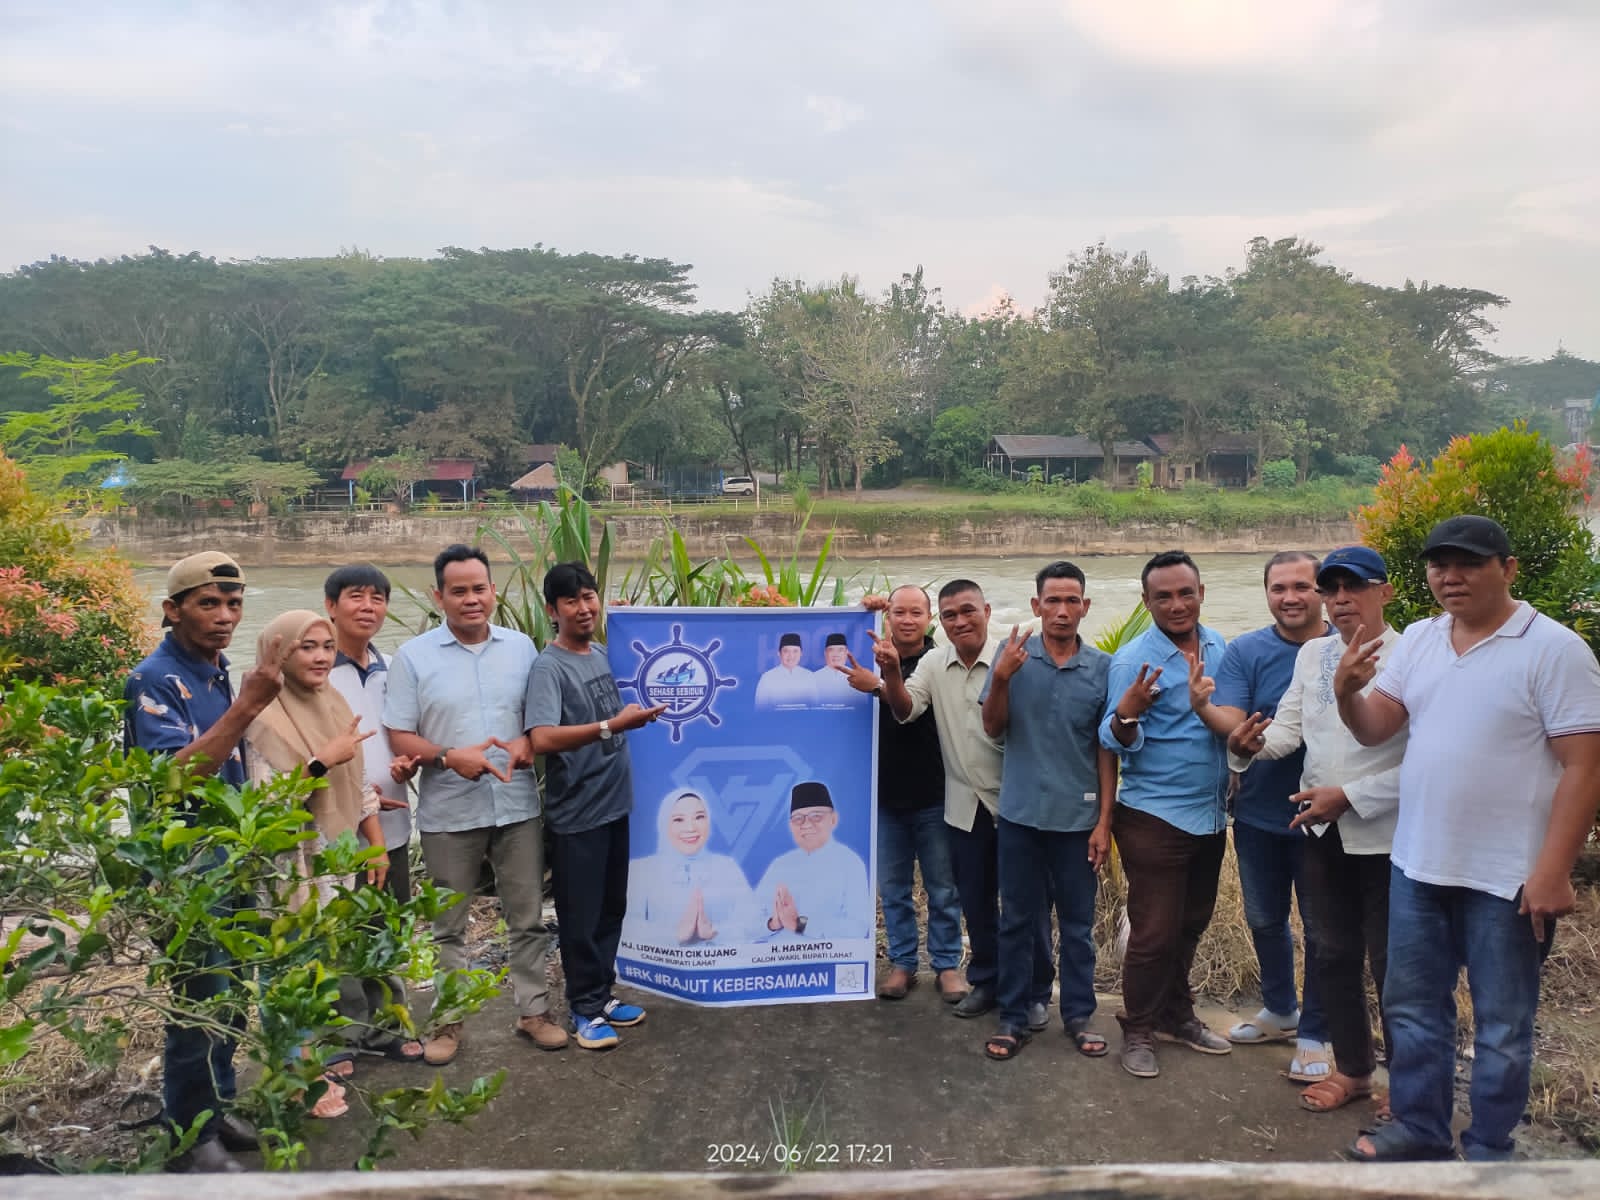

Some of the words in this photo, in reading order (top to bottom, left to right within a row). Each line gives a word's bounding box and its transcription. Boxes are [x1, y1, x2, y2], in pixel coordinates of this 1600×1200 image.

[648, 687, 675, 696] SEHASE
[636, 944, 683, 957] LIDYAWATI
[685, 949, 702, 958] CIK
[703, 948, 737, 958] UJANG
[771, 944, 781, 953] H.
[782, 942, 833, 953] HARYANTO
[640, 953, 664, 963] CALON
[665, 958, 691, 967] BUPATI
[692, 959, 716, 967] LAHAT
[751, 955, 776, 963] CALON
[777, 953, 800, 961] WAKIL
[802, 952, 828, 960] BUPATI
[829, 951, 853, 959] LAHAT
[624, 964, 653, 982] #RK
[654, 972, 710, 994] #RAJUT
[712, 972, 829, 994] KEBERSAMAAN
